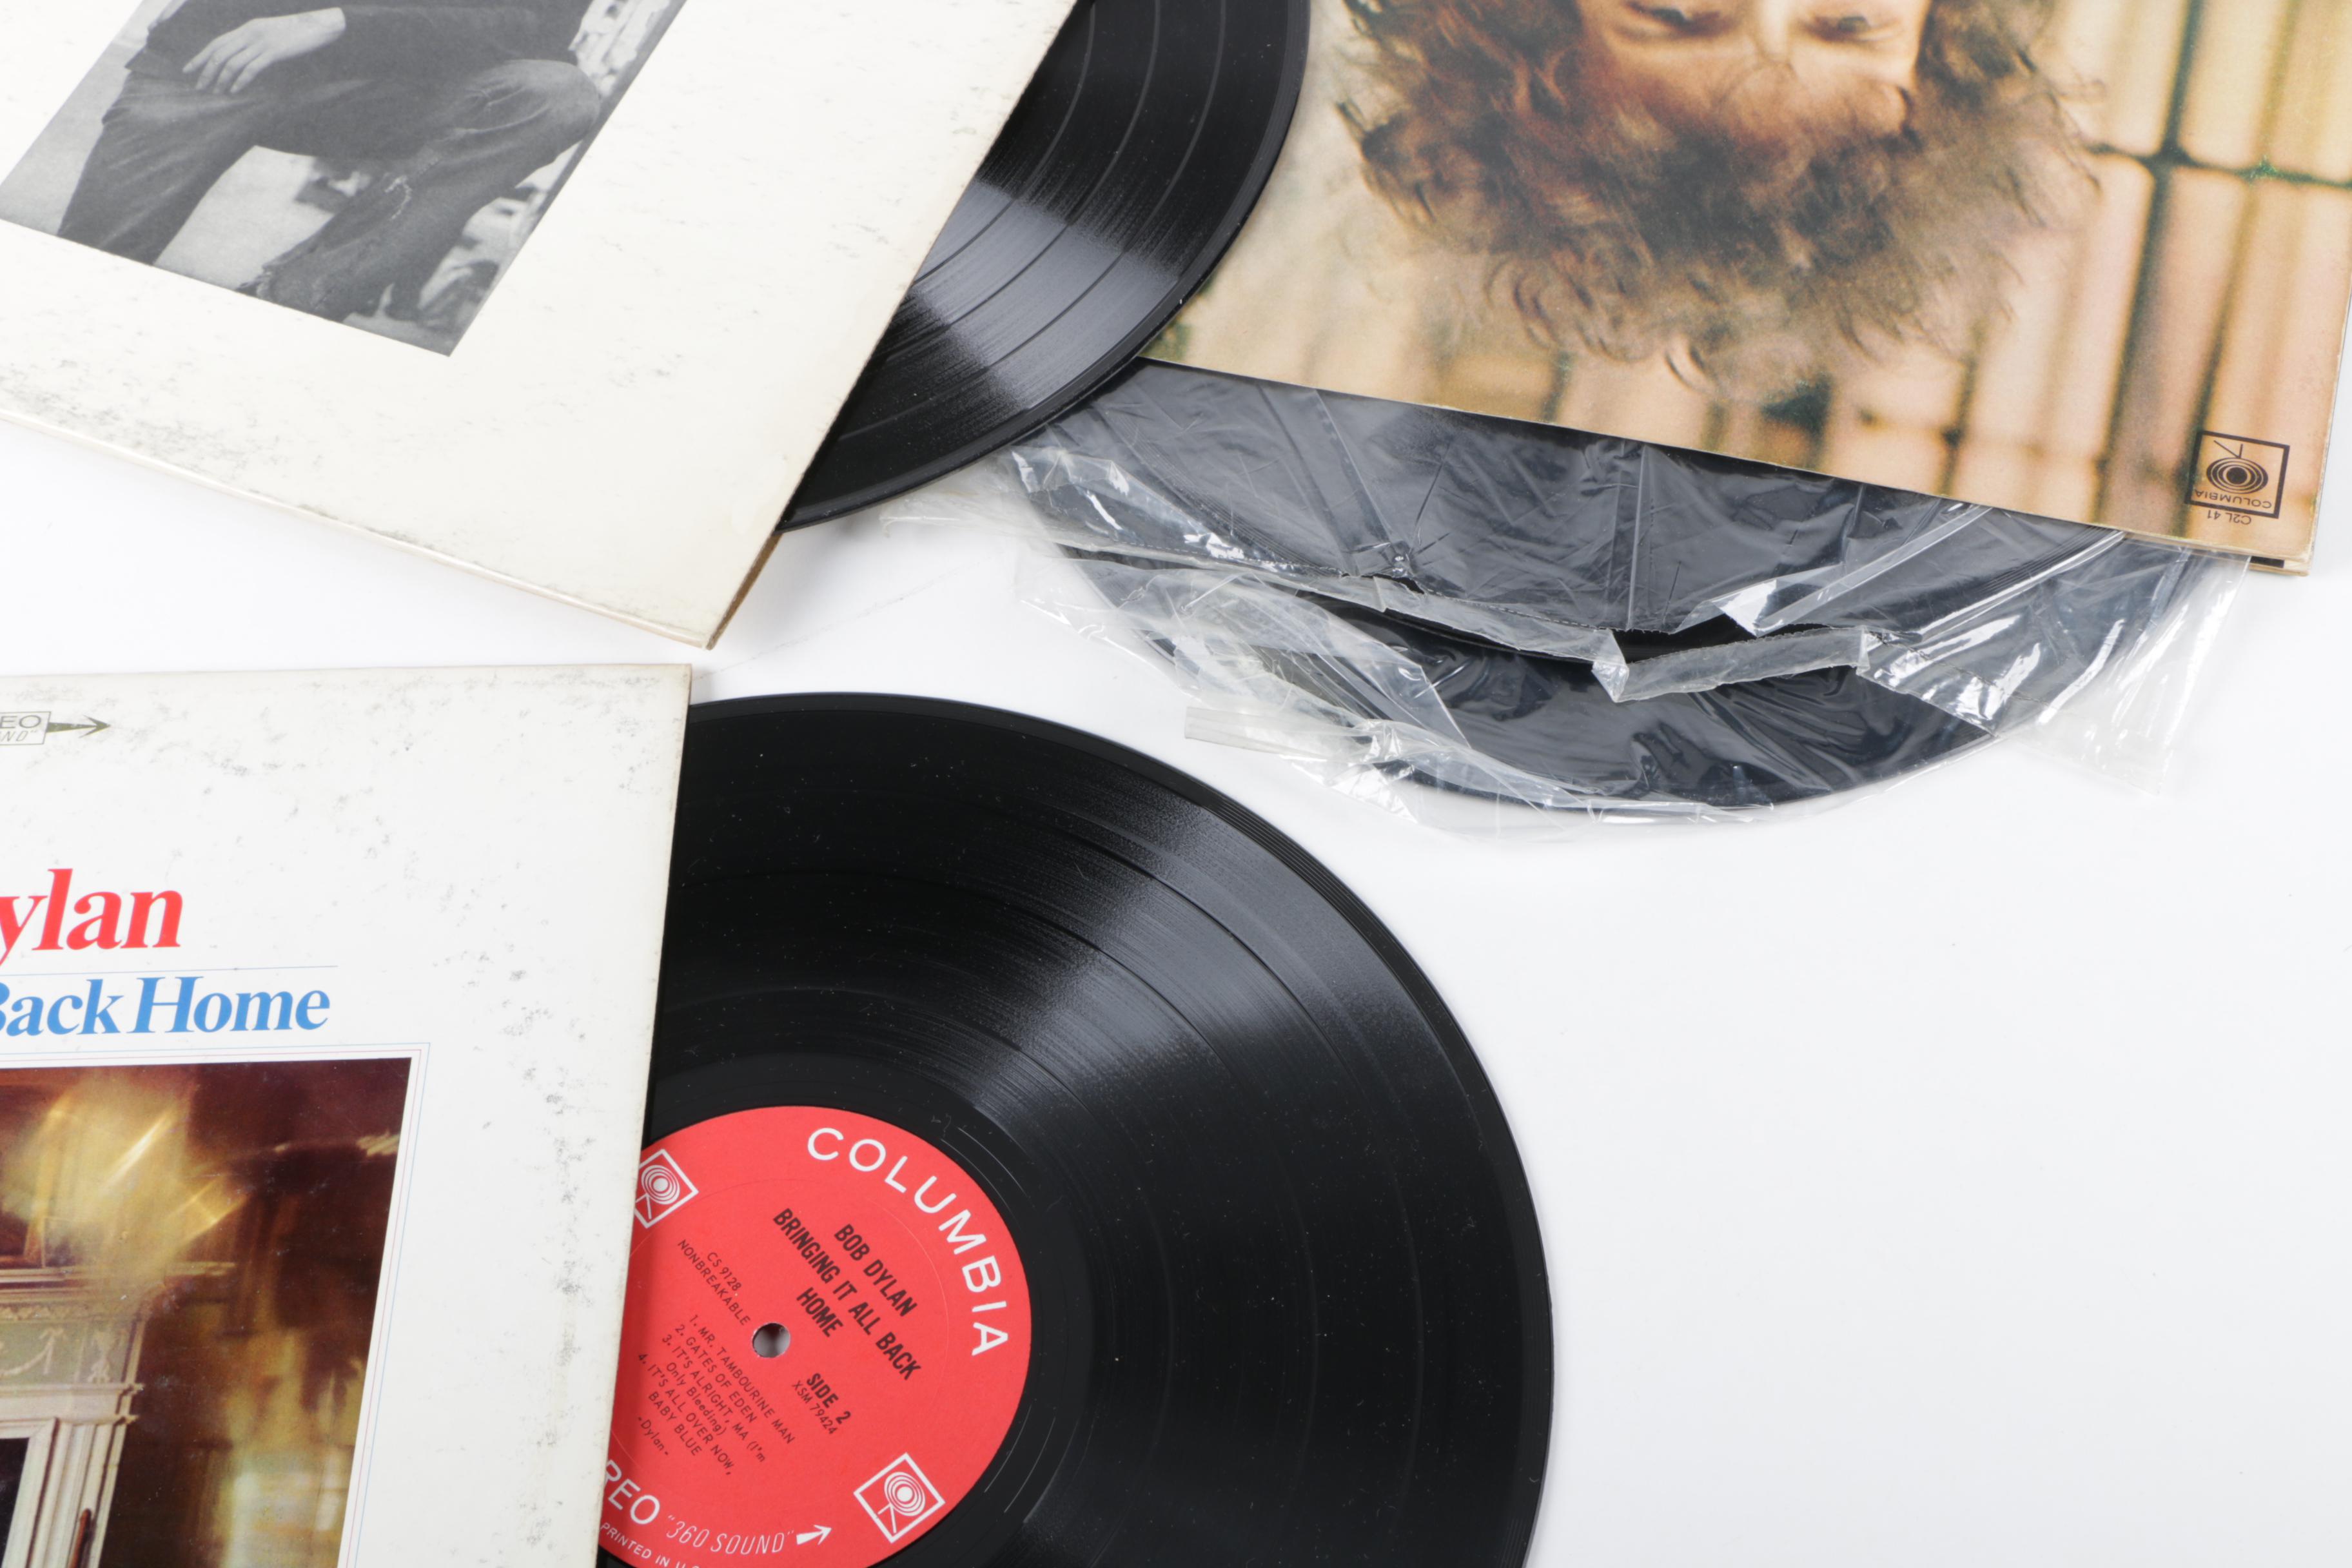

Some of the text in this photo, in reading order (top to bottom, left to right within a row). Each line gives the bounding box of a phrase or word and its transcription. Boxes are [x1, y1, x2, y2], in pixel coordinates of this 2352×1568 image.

[2194, 489, 2272, 509] COLUMBIA
[2207, 509, 2252, 525] C2L 41
[126, 975, 331, 1034] Home
[707, 1251, 742, 1291] CS 9128
[807, 1127, 1009, 1357] COLUMBIA
[834, 1224, 918, 1317] BOB DYLAN
[678, 1239, 750, 1326] NONBREAKABLE
[773, 1208, 921, 1380] BRINGING IT ALL BACK
[796, 1287, 843, 1338] HOME
[662, 1334, 672, 1346] 3.
[672, 1346, 693, 1369] IT'S
[691, 1370, 734, 1424] ALRIGHT,
[732, 1422, 749, 1441] MA
[666, 1362, 727, 1436] Only Bleeding)
[674, 1324, 758, 1423] 2. GATES OF EDEN
[689, 1314, 796, 1444] 1. MR. TAMBOURINE MAN
[792, 1380, 838, 1435] XSM 79424
[806, 1373, 852, 1424] SIDE 2
[647, 1364, 669, 1387] IT'S
[665, 1388, 688, 1413] ALL
[685, 1412, 714, 1444] OVER
[710, 1444, 734, 1476] NOW,
[648, 1391, 703, 1456] BABY BLUE
[600, 1522, 671, 1567] PRINTED IN
